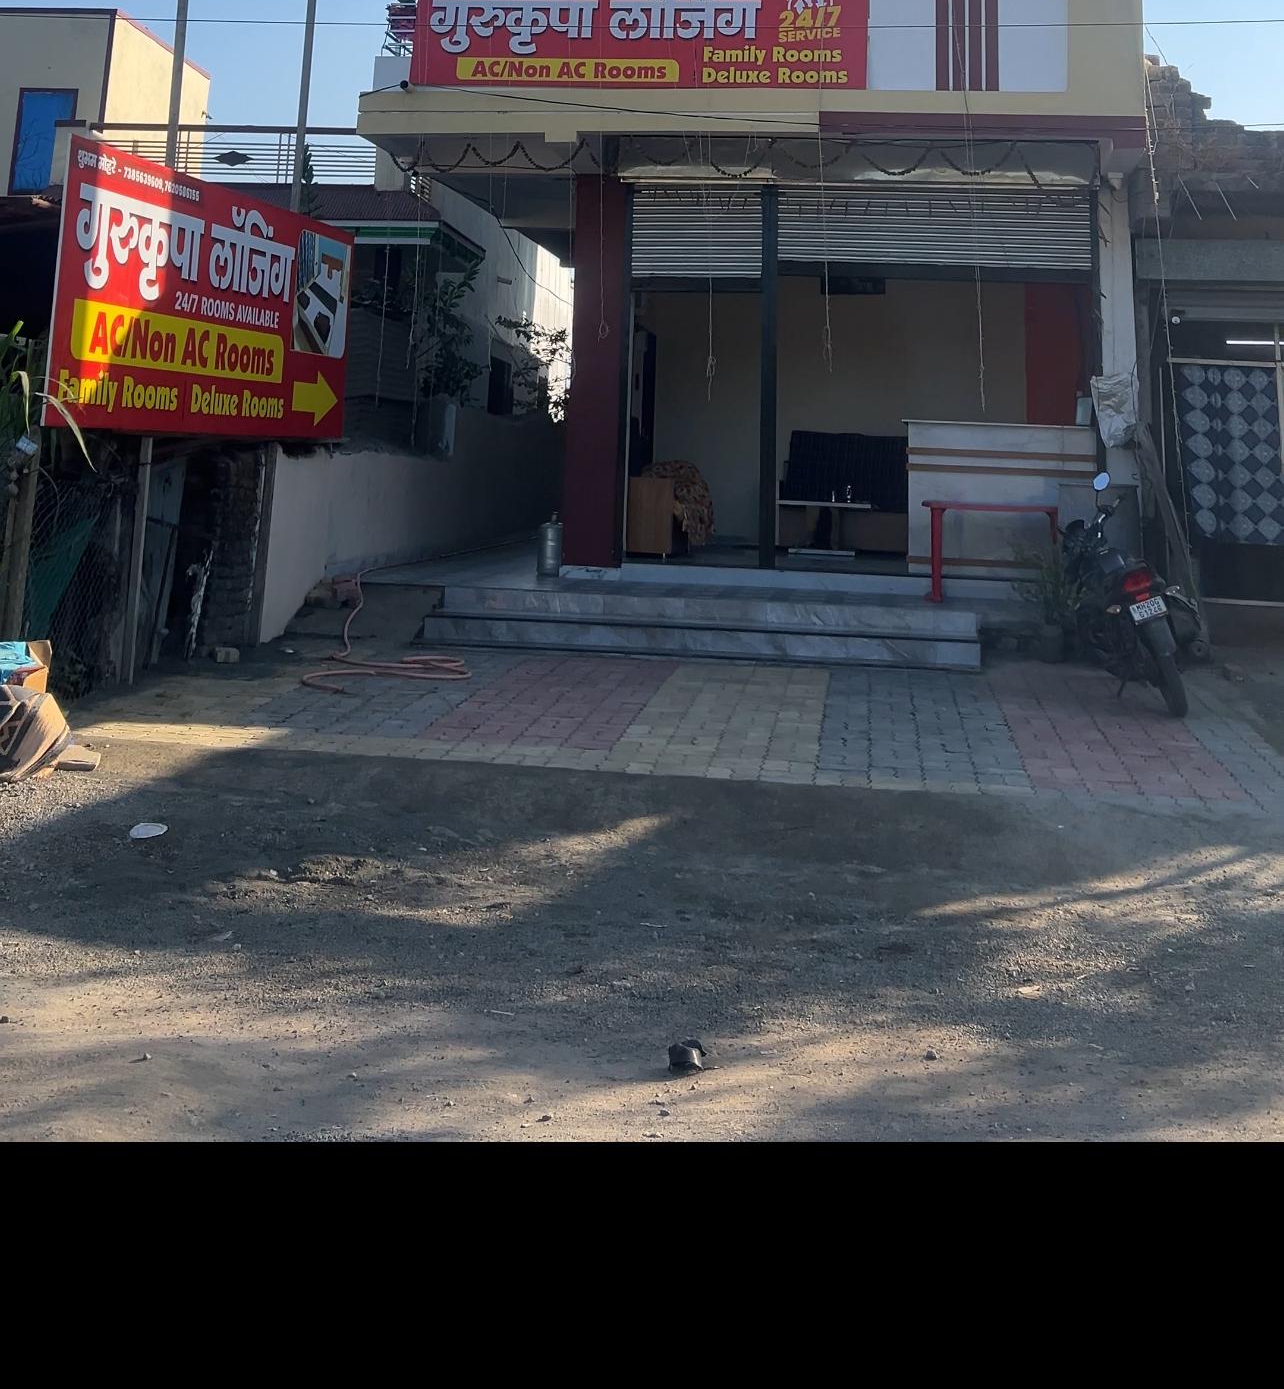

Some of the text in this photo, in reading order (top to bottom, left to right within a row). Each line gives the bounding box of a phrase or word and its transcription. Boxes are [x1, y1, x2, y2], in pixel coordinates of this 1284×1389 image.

[779, 6, 841, 28] 24/7
[778, 27, 841, 42] SERVICE
[703, 45, 842, 65] Family Rooms
[471, 61, 667, 80] AC/Non AC Rooms
[702, 67, 848, 84] Deluxe Rooms
[76, 183, 296, 302] गुरुकृपा लॉजिंग
[175, 291, 280, 329] 24/7 ROOMS AVAILABLE
[88, 312, 275, 376] AC/Non AC Rooms
[57, 368, 284, 419] Family Rooms Deluxe Rooms
